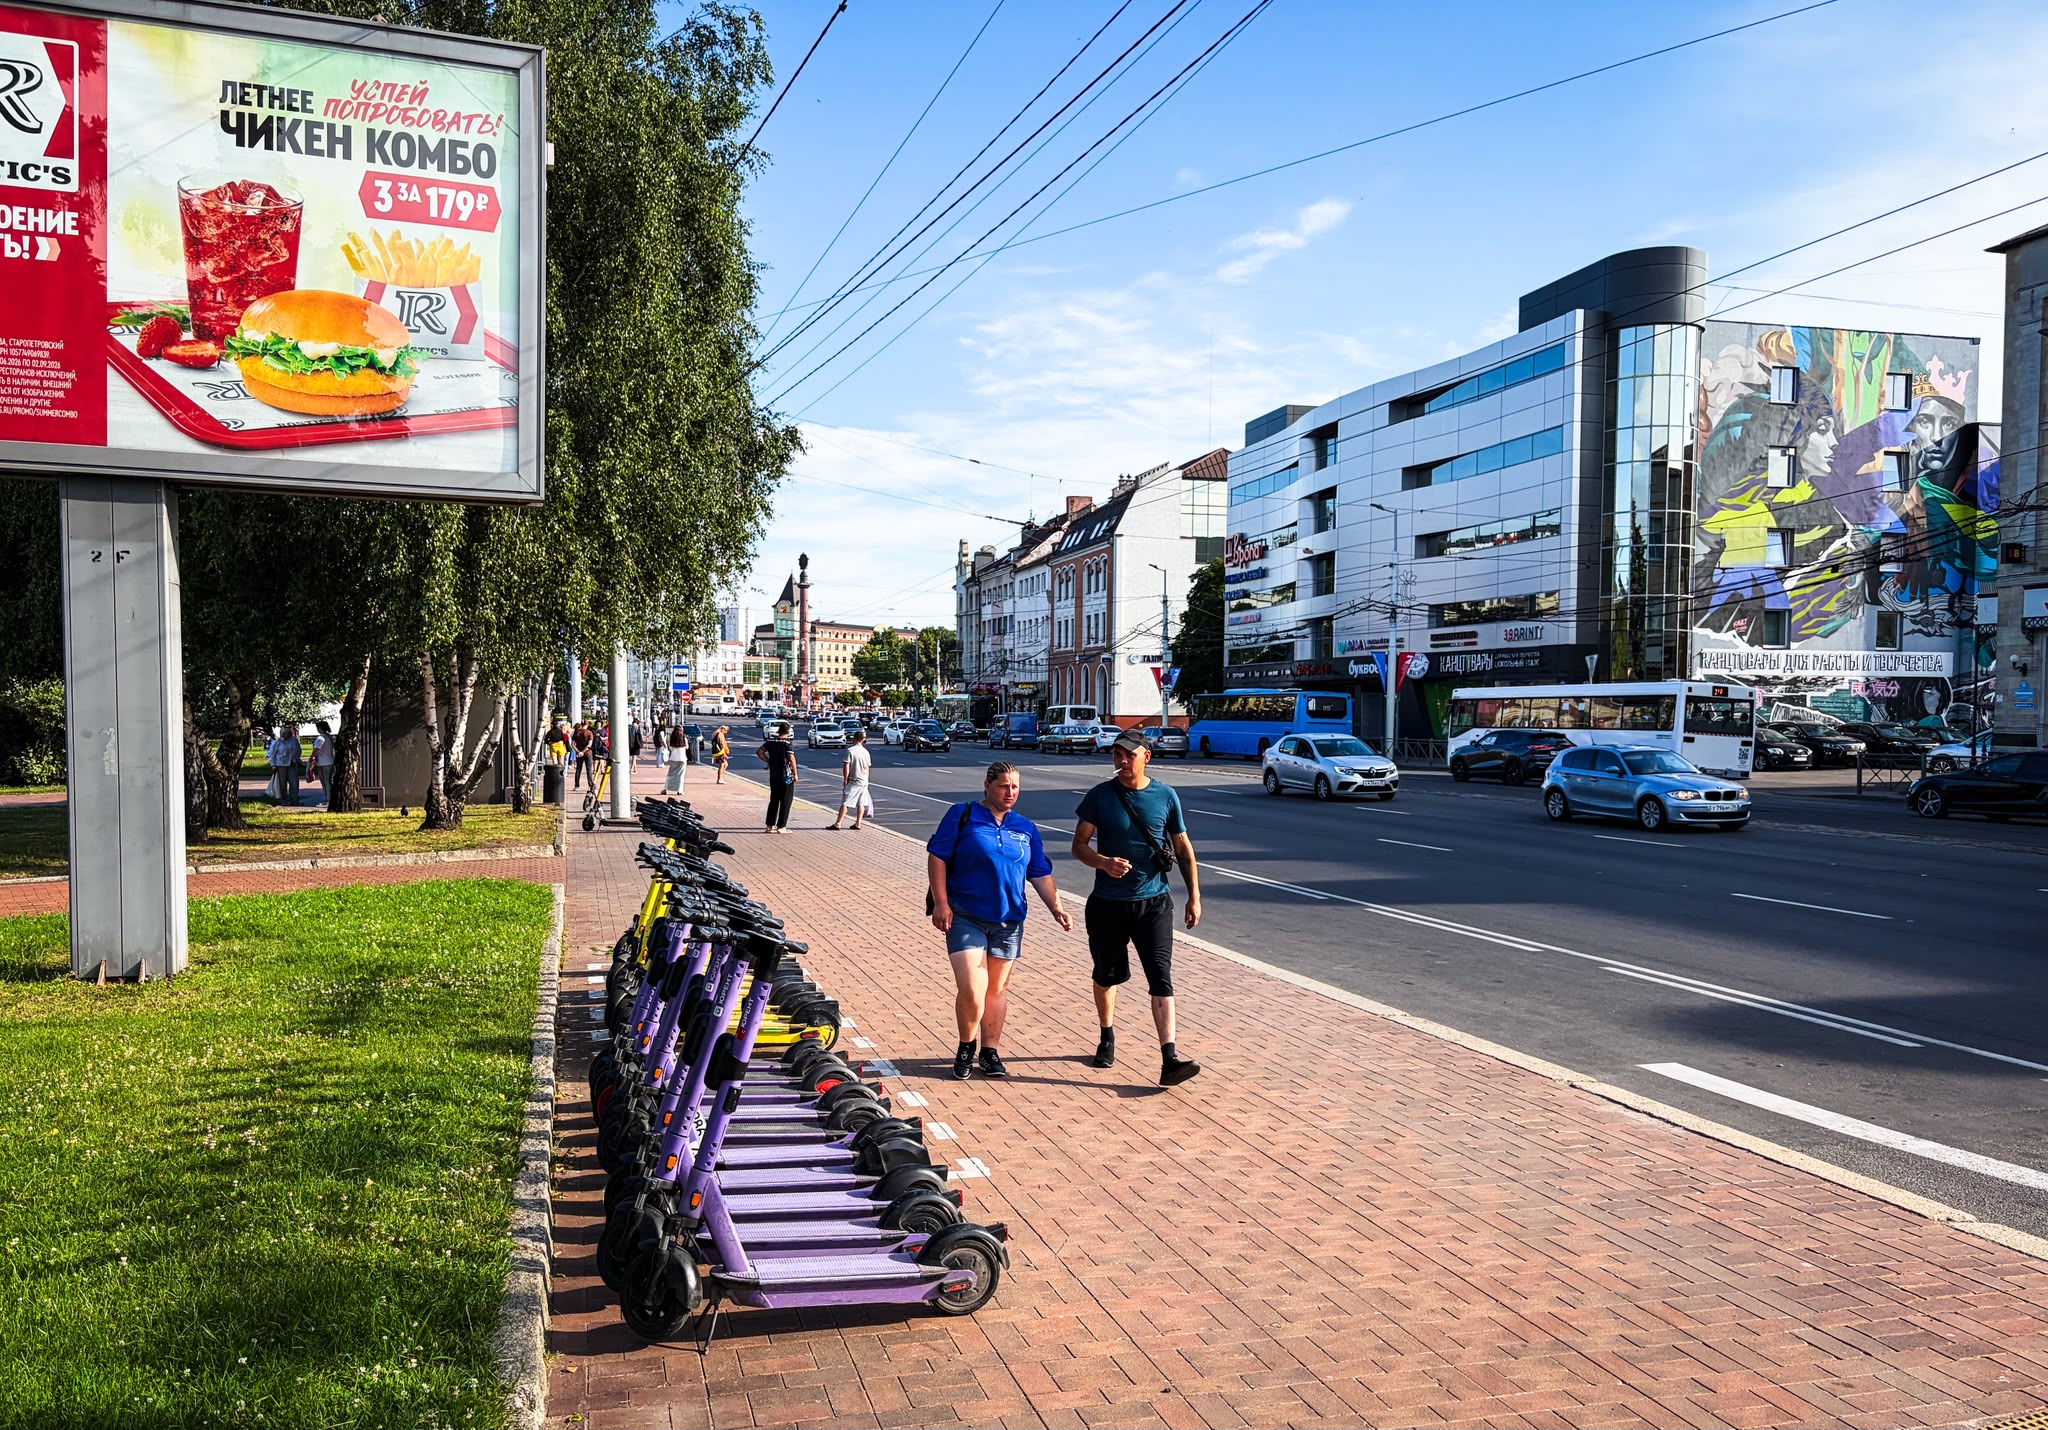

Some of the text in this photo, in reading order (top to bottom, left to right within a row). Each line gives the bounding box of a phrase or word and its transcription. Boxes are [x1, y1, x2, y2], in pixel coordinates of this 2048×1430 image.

[219, 79, 314, 115] ЛЕТНЕЕ
[350, 79, 430, 107] УСПЕЙ
[323, 98, 504, 138] ПОПРОБОВАТЬ!
[219, 109, 497, 179] ЧИКЕН КОМБО
[0, 160, 72, 185] IC'S
[373, 179, 393, 213] 3
[9, 338, 64, 350] СТАРОПЕТРОВСКИЙ
[22, 358, 31, 367] ПО
[6, 376, 11, 385] В
[42, 379, 72, 390] ВНЕШНИЙ
[12, 387, 21, 396] ОТ
[21, 388, 66, 399] ИЗОБРАЖЕНИЯ.
[24, 397, 29, 406] И
[29, 398, 52, 408] ДРУГИЕ
[1702, 651, 1944, 673] КАНЦТОВАРЫ ДЛЯ РАБОТЫ И ТВОРЧЕСТВА
[710, 953, 723, 981] ЮРЕНТ
[720, 973, 733, 1005] ЮРЕНТ
[740, 998, 754, 1028] ЮРЕНТ
